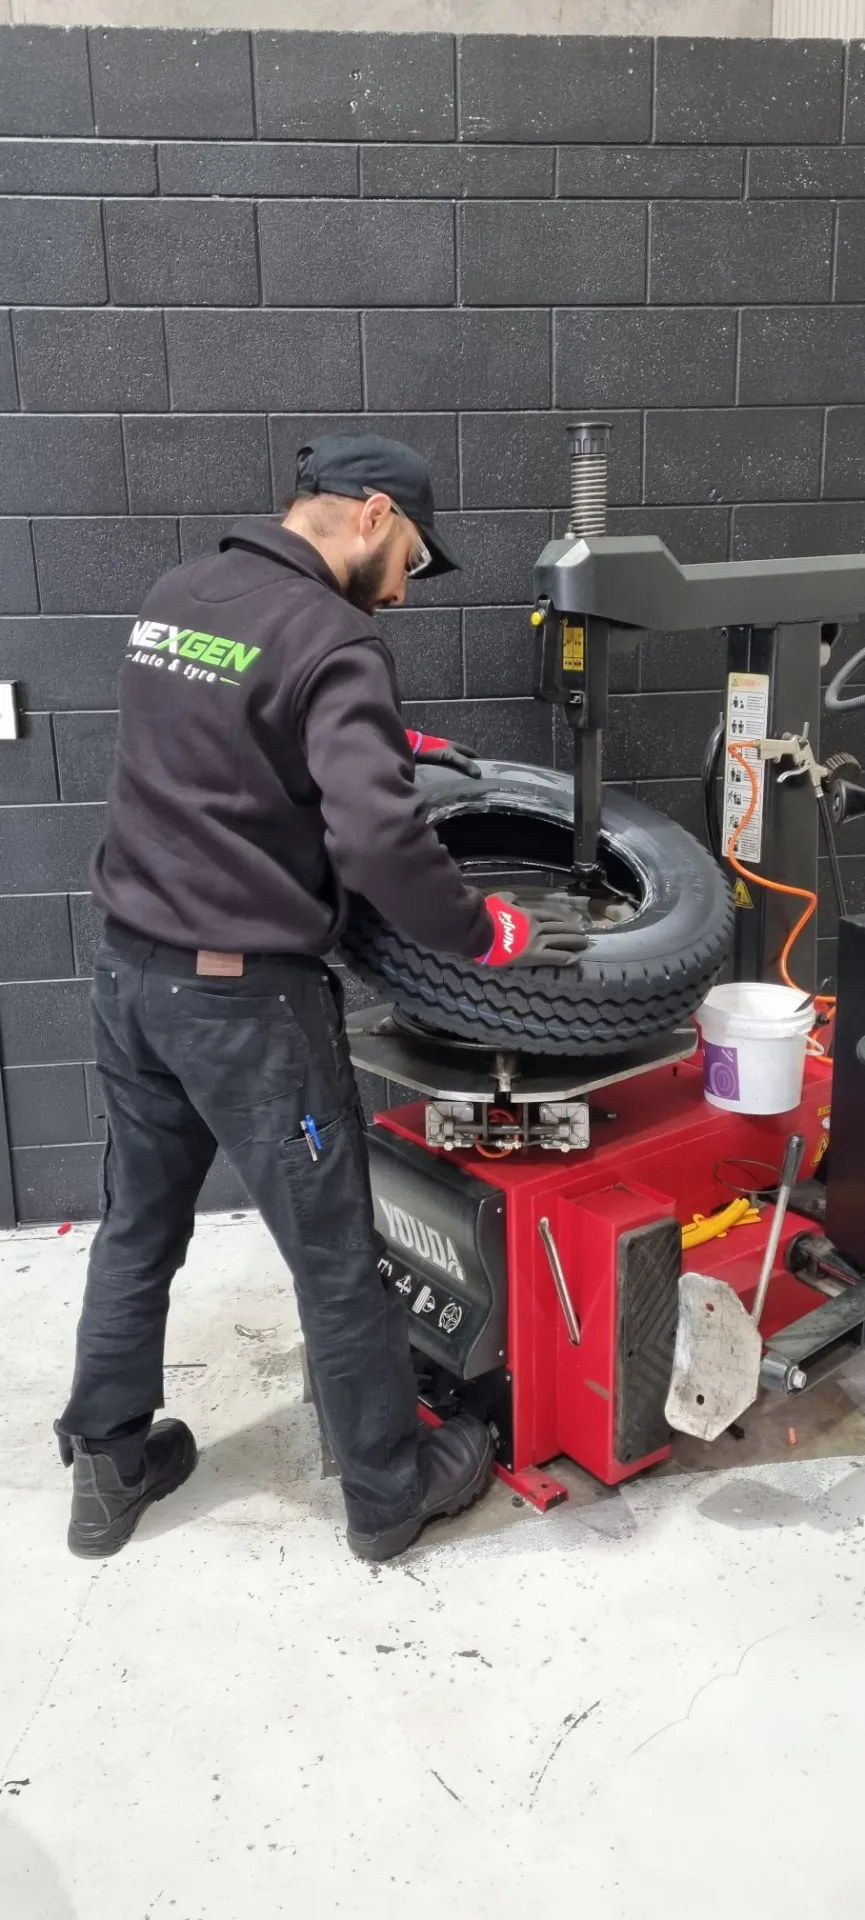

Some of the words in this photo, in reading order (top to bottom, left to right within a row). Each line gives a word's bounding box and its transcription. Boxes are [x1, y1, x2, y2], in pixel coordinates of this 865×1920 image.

[127, 620, 261, 672] NEXGEN
[131, 650, 164, 668] Auto
[168, 658, 180, 672] &
[183, 663, 217, 682] tyre
[498, 910, 516, 954] NINJA
[376, 1194, 465, 1281] YOUDA
